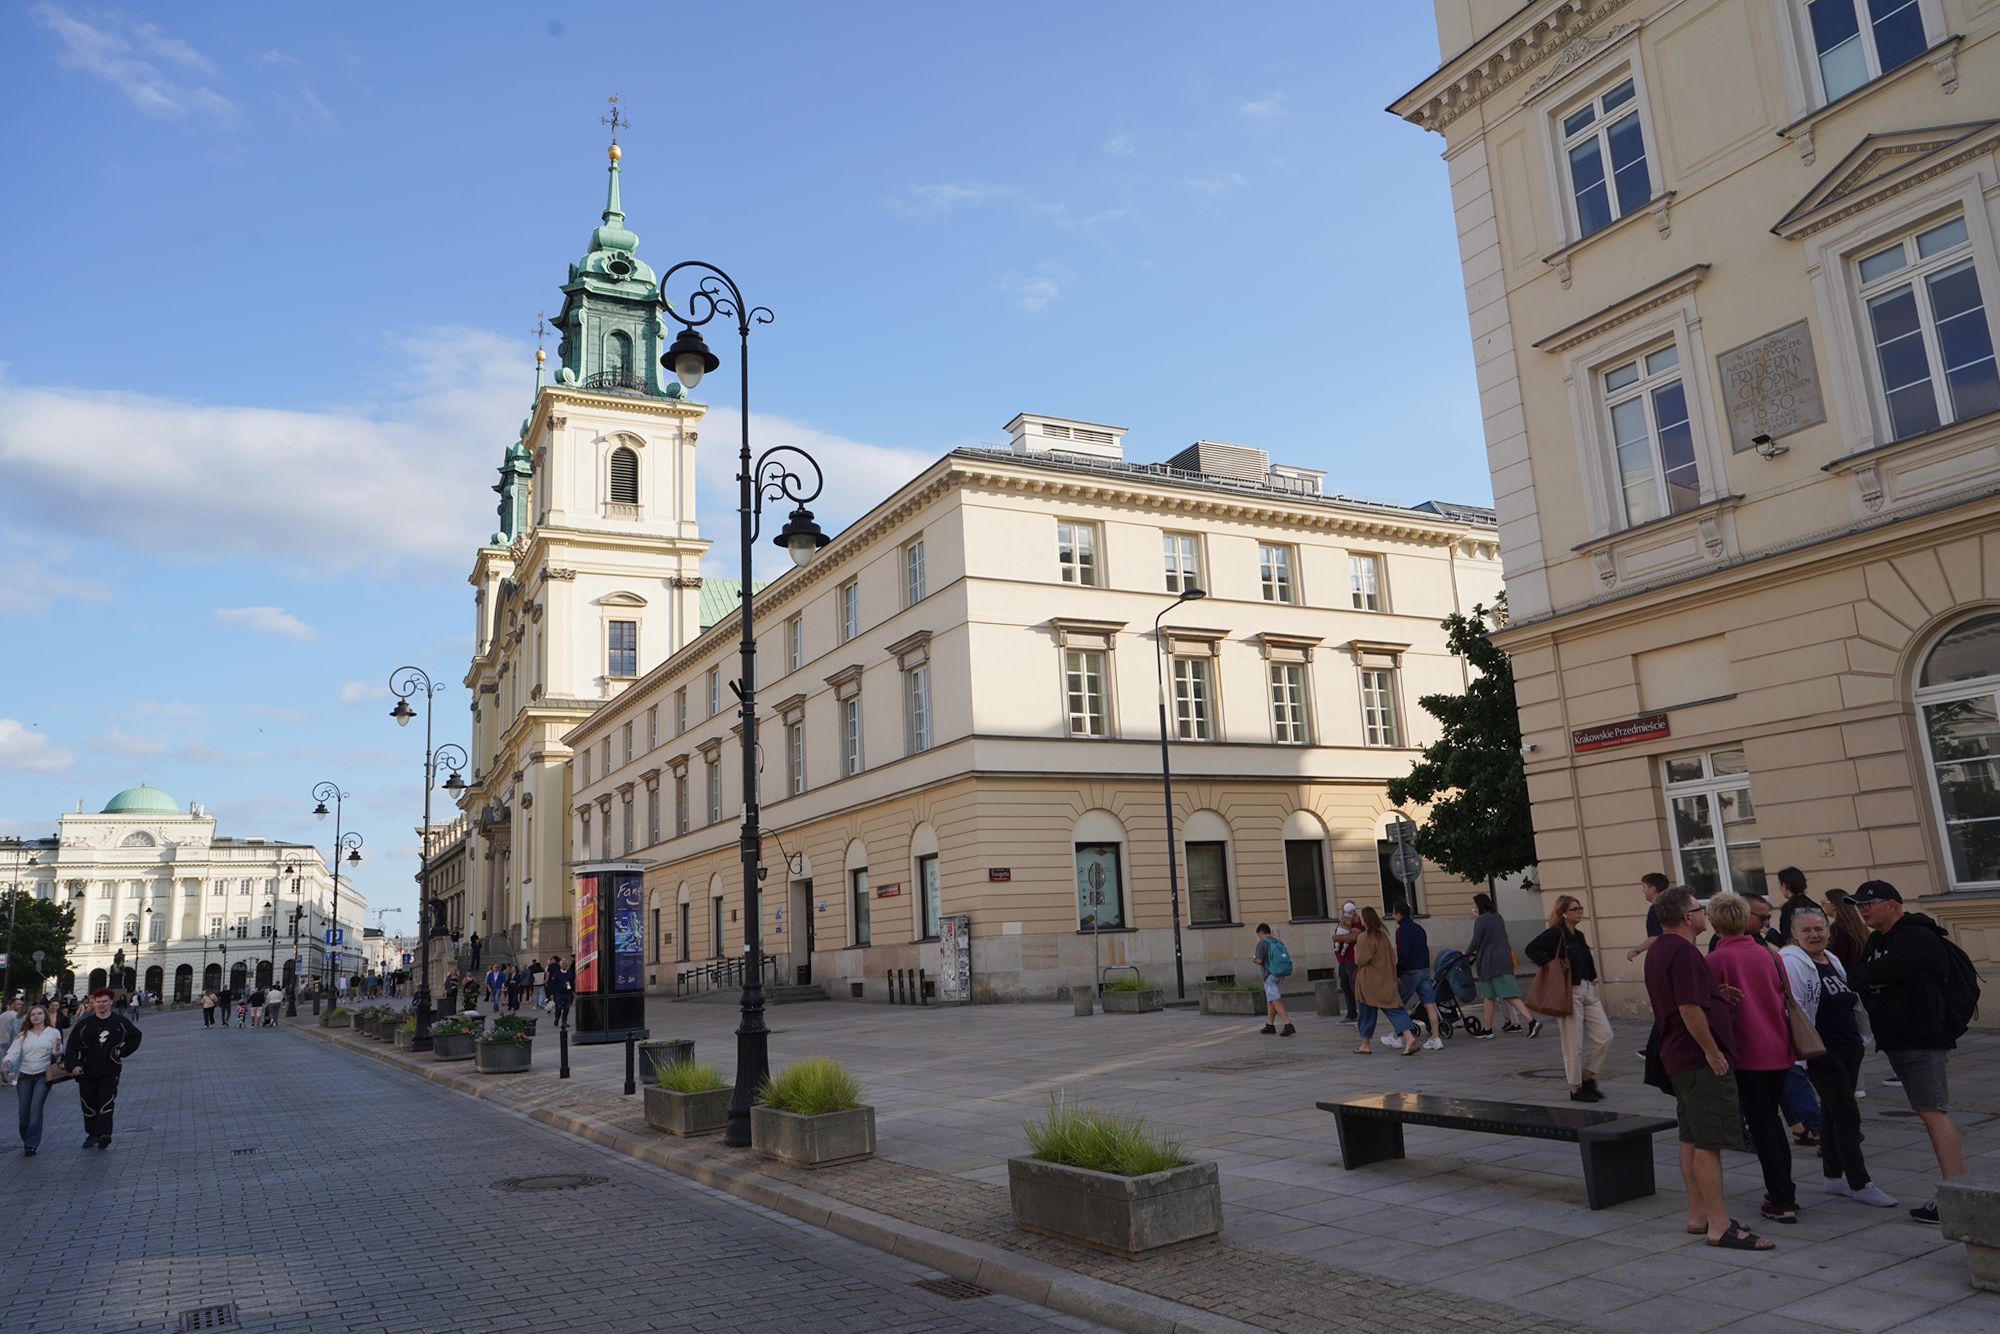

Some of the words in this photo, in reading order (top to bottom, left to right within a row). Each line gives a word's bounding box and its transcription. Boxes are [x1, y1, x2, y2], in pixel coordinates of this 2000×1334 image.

[1763, 336, 1788, 350] DOMU
[1731, 348, 1801, 388] FRYDERYK
[1739, 365, 1799, 400] CHOPIN
[1749, 392, 1795, 420] 1830
[1574, 729, 1614, 745] Krakowskie
[1615, 720, 1666, 737] Przedmieście
[617, 882, 643, 905] Fang
[1822, 975, 1852, 996] GA
